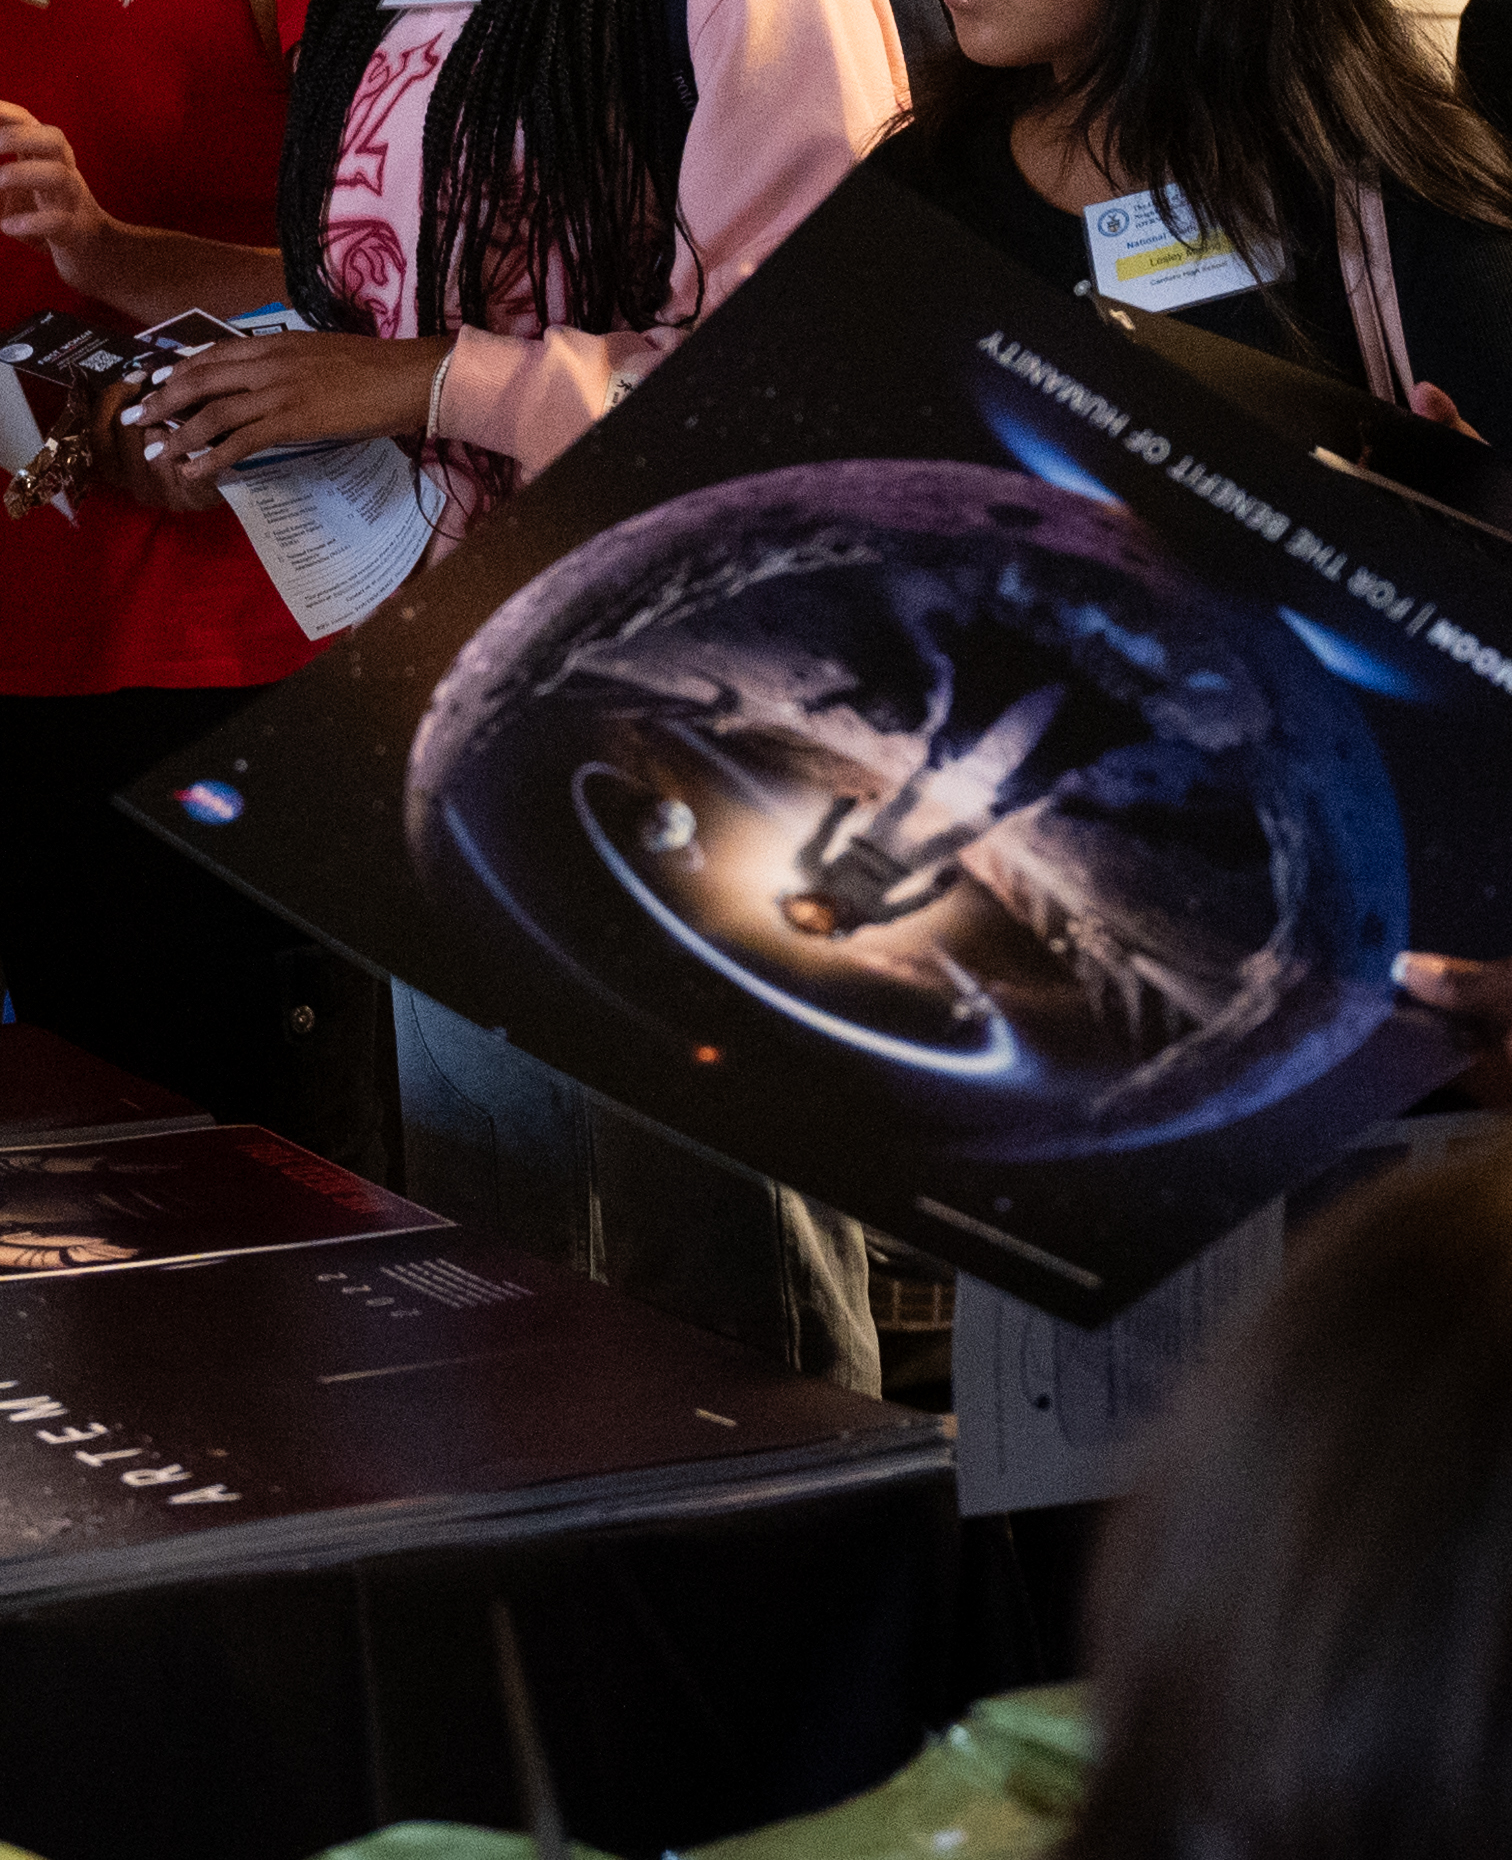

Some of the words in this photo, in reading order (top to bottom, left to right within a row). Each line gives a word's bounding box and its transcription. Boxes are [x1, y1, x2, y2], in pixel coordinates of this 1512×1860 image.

[978, 330, 1130, 438] HUMANITY
[1123, 427, 1172, 466] OF
[1168, 453, 1289, 543] BENEFIT
[1285, 526, 1347, 583] THE
[1348, 565, 1414, 632] FOR
